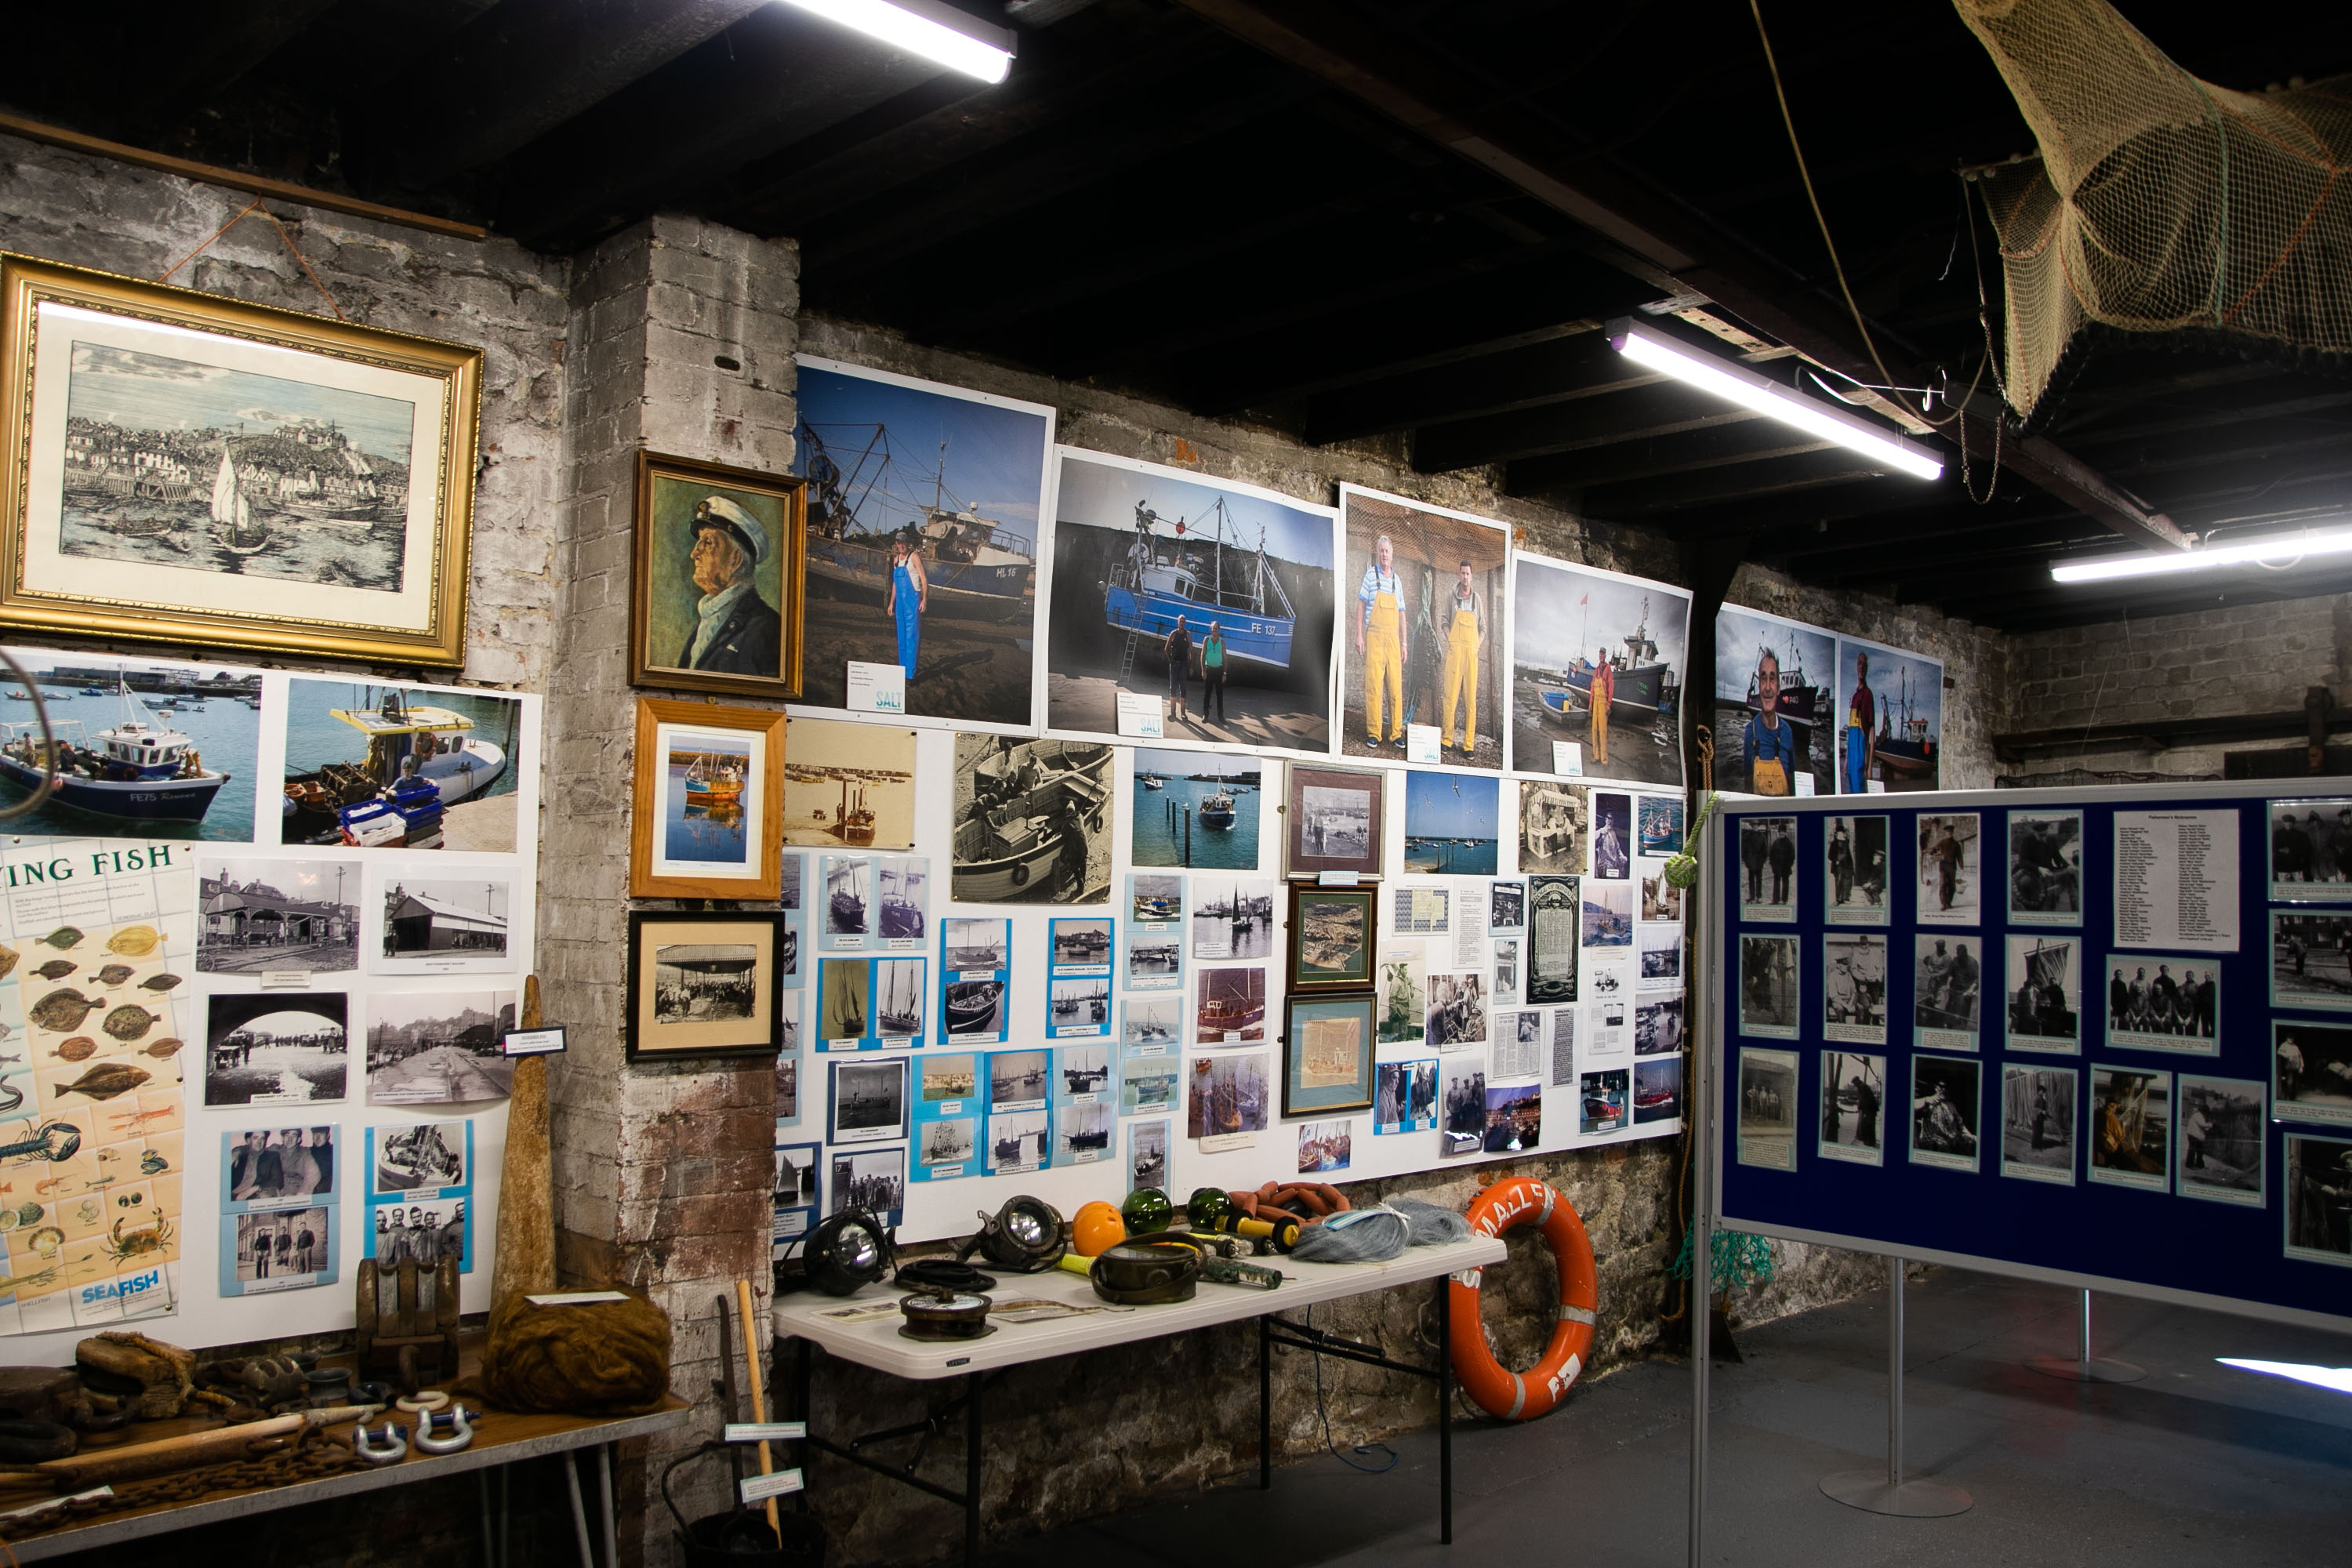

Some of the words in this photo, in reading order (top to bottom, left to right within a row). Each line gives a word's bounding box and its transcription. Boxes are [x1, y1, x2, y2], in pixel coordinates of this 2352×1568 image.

[1251, 622, 1262, 634] FE
[1265, 625, 1276, 636] 137
[876, 691, 903, 708] SALT
[1141, 717, 1162, 733] SALT
[129, 793, 157, 802] FE75
[91, 844, 173, 876] FISH
[82, 1269, 159, 1305] SEAFISH
